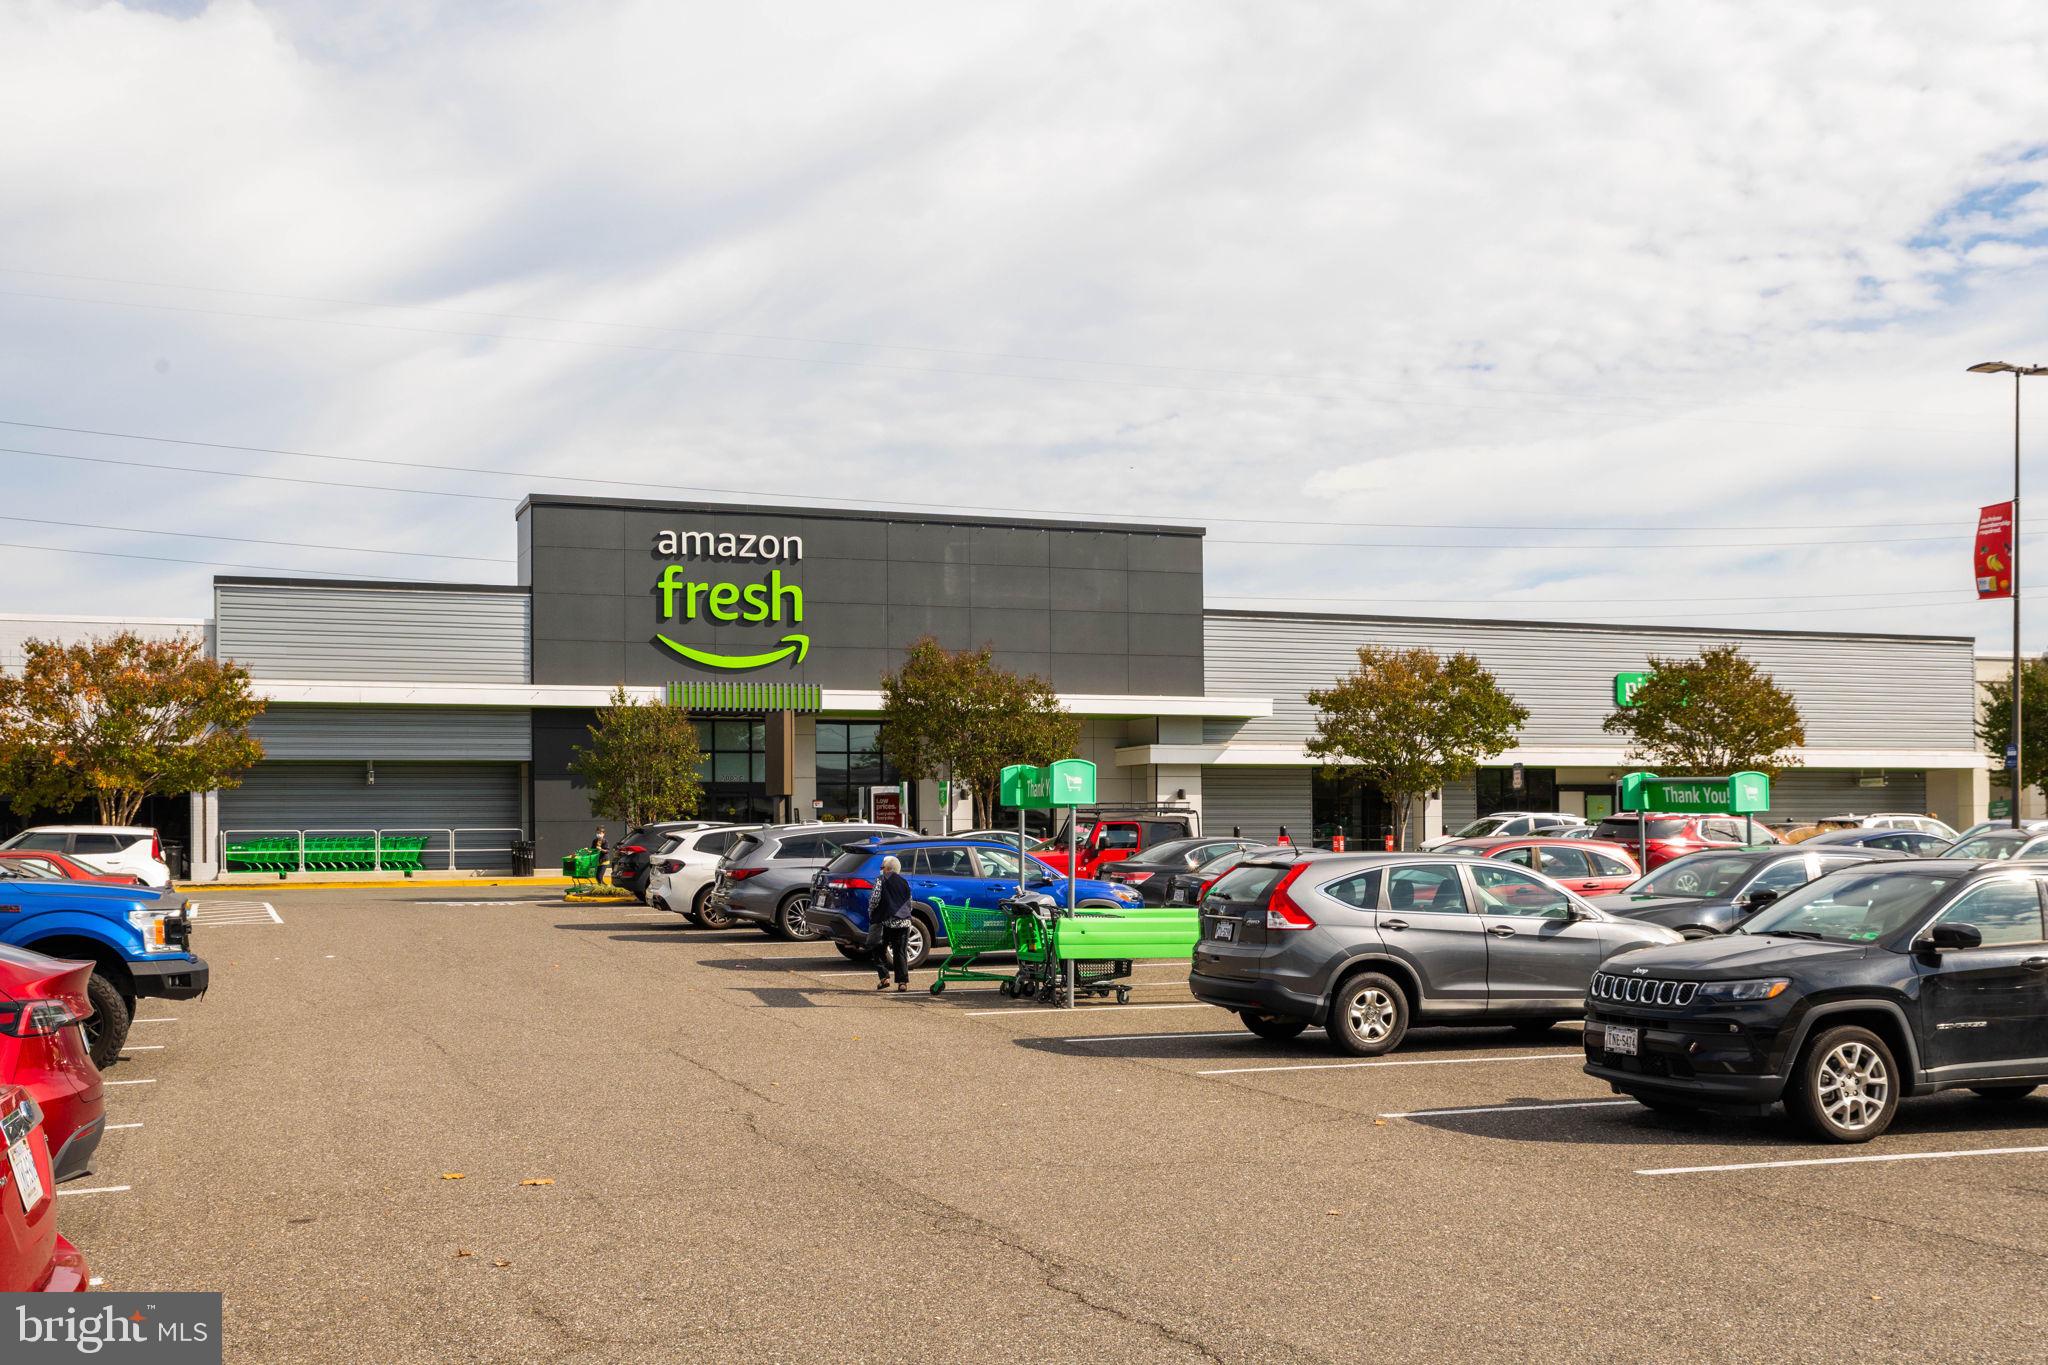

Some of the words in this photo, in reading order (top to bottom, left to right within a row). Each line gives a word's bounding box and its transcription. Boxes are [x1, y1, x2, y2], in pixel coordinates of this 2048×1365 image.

[658, 530, 803, 559] amazon
[657, 564, 803, 622] fresh
[1027, 778, 1045, 798] Thank
[1662, 785, 1700, 804] Thank
[1703, 786, 1731, 804] You!
